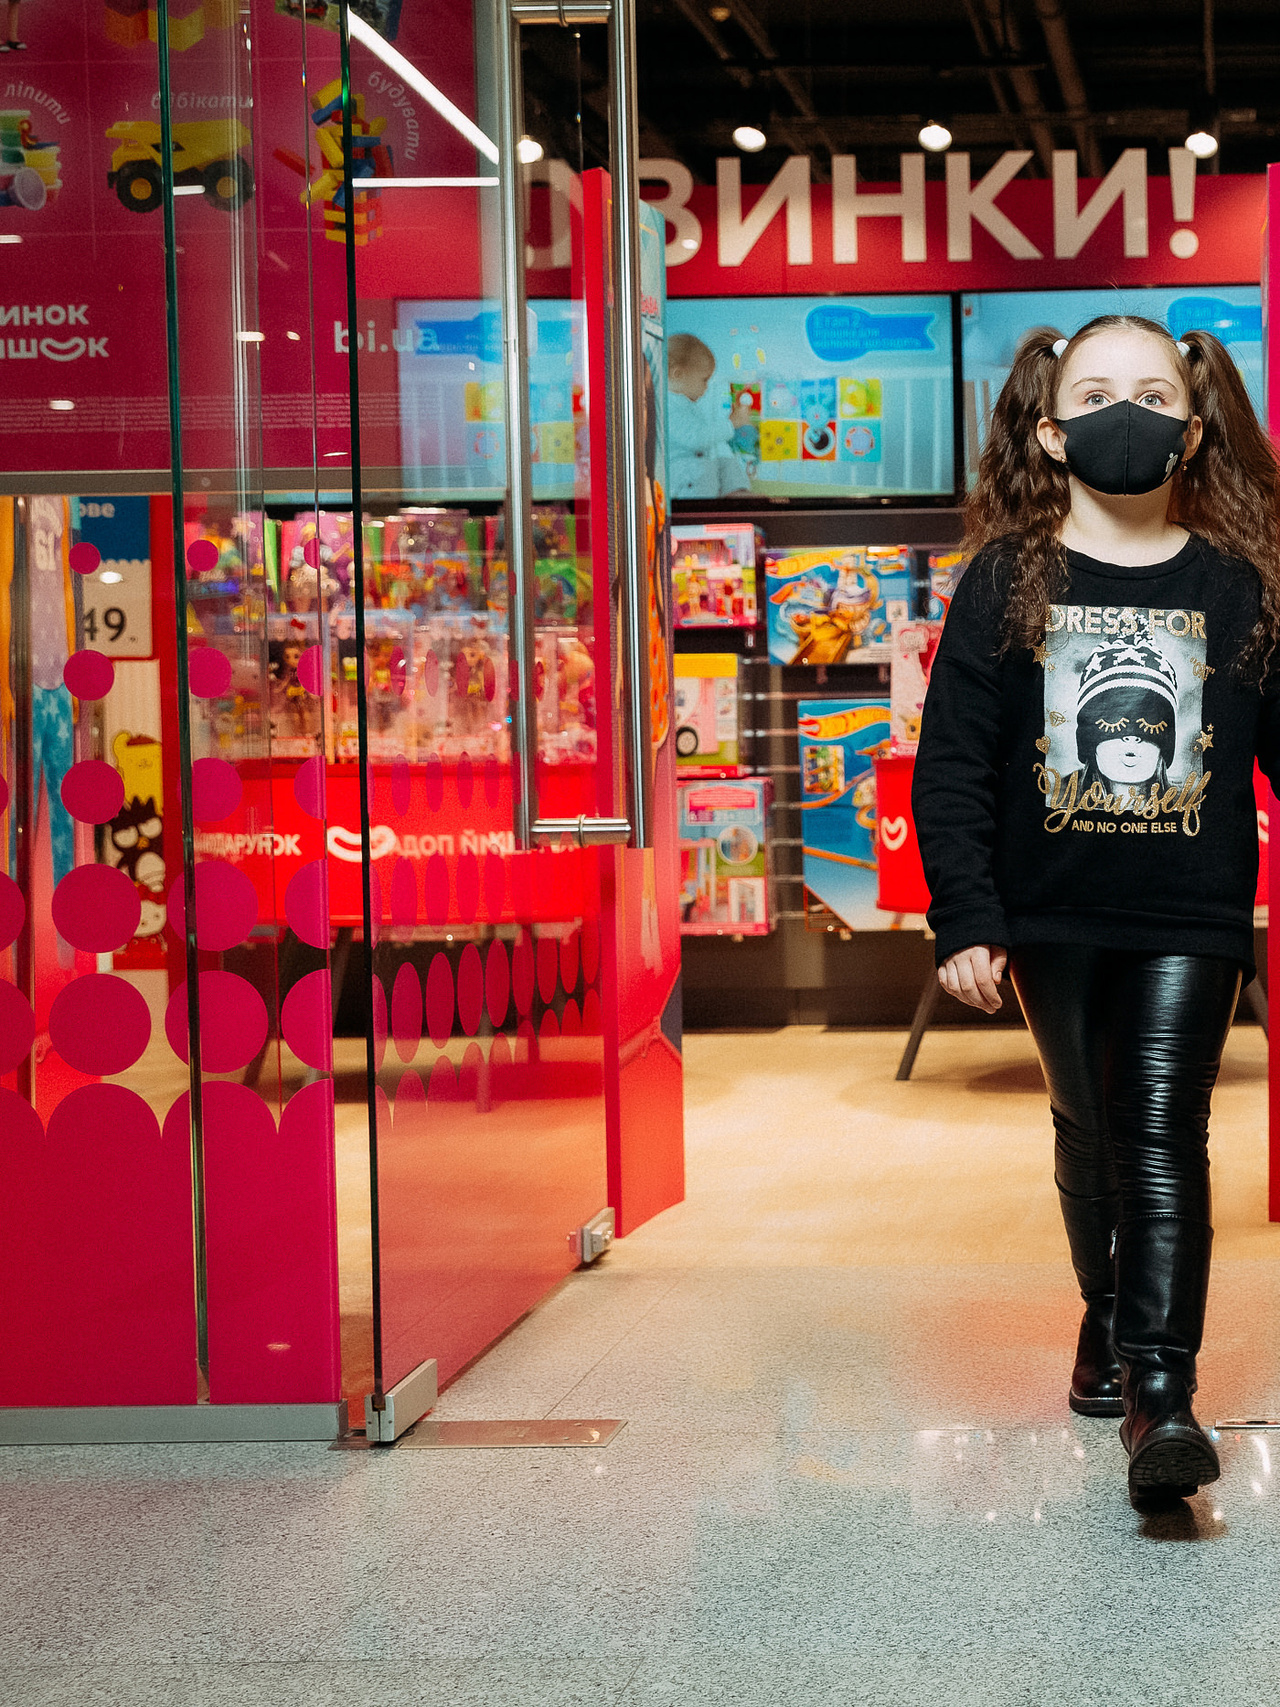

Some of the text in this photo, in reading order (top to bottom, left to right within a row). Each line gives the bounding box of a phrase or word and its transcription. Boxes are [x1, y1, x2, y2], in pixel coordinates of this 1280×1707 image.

[367, 71, 420, 161] будувати
[333, 320, 440, 353] bi.ua
[1045, 603, 1208, 640] DRESS FOR
[1032, 761, 1212, 838] Yourself
[1071, 819, 1178, 834] AND NO ONE ELSE
